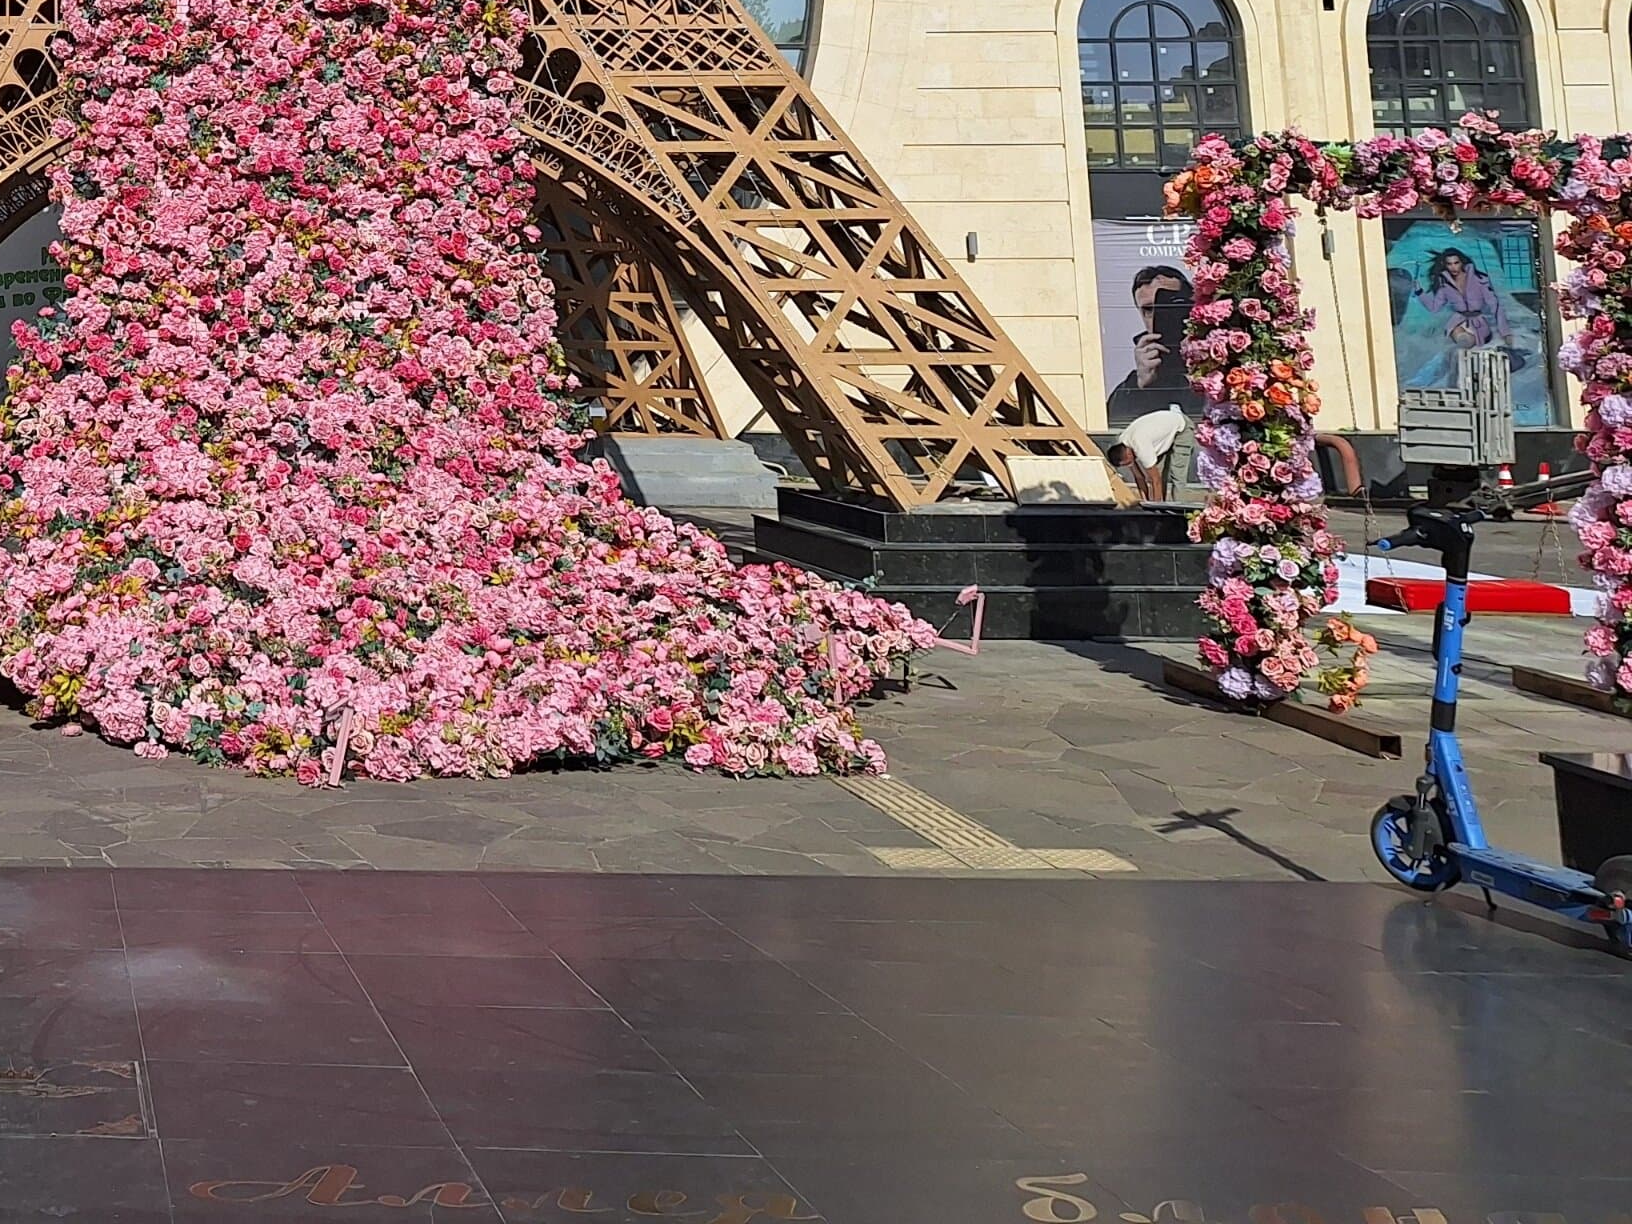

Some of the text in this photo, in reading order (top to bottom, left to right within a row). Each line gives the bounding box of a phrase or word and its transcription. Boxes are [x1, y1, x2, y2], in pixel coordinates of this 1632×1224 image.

[1139, 245, 1186, 257] COMPA
[12, 291, 36, 307] во
[1443, 607, 1456, 631] JET
